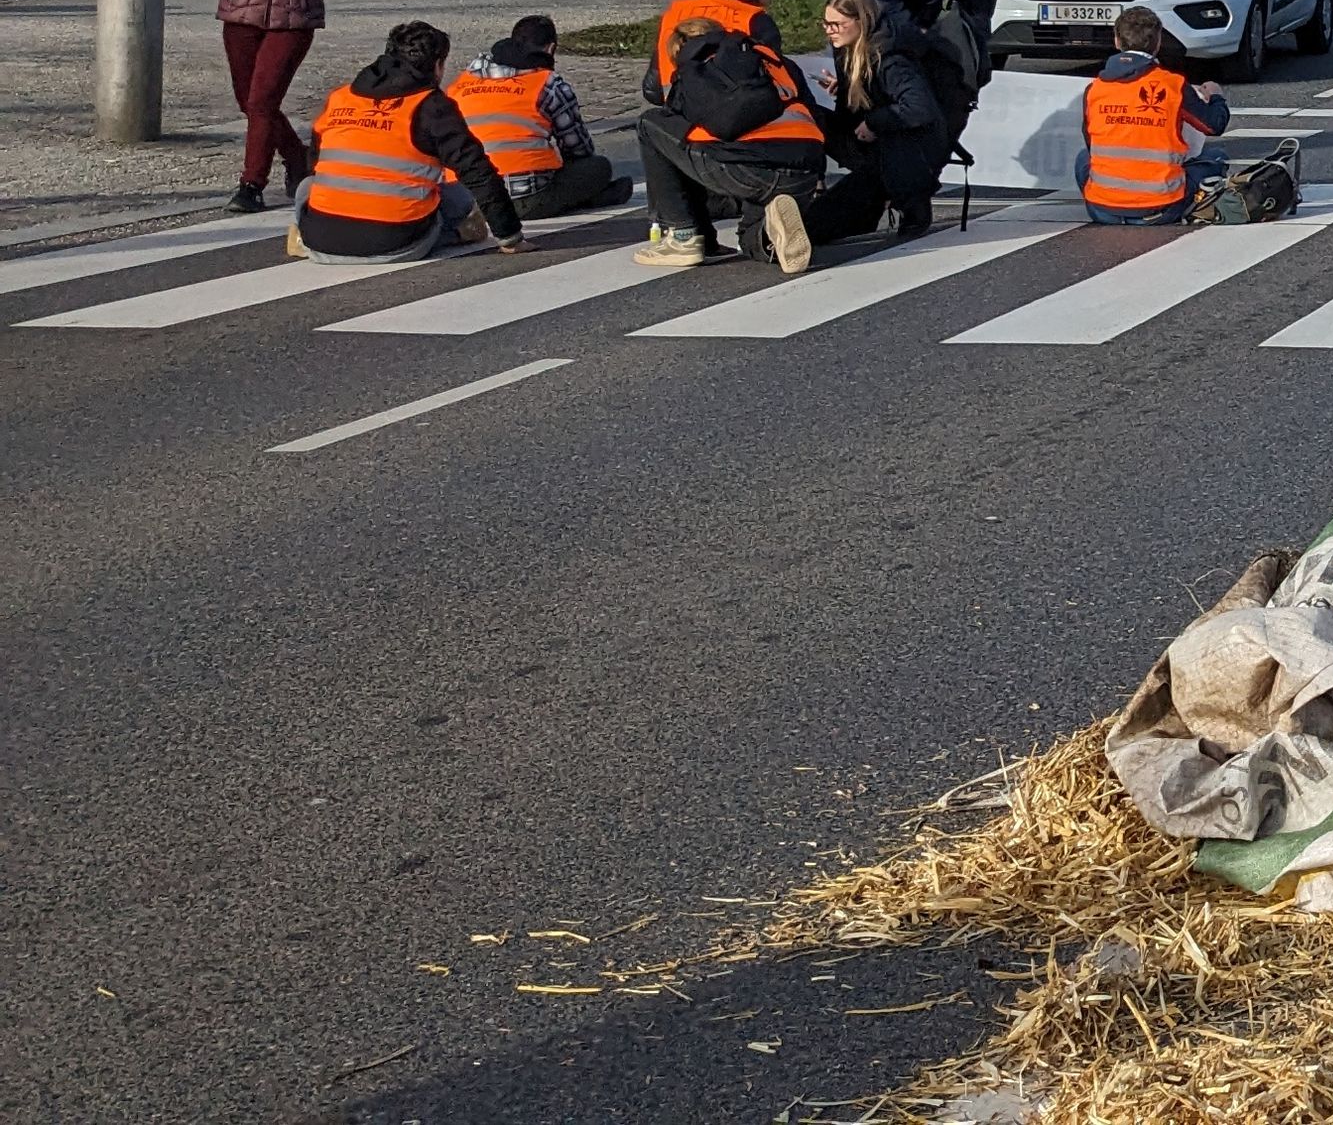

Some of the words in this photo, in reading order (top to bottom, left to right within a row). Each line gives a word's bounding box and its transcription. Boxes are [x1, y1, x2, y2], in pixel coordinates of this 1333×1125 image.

[462, 81, 527, 97] GENERATION.AT
[1099, 104, 1129, 114] LETZTE
[1105, 115, 1168, 128] GENERATION.AT
